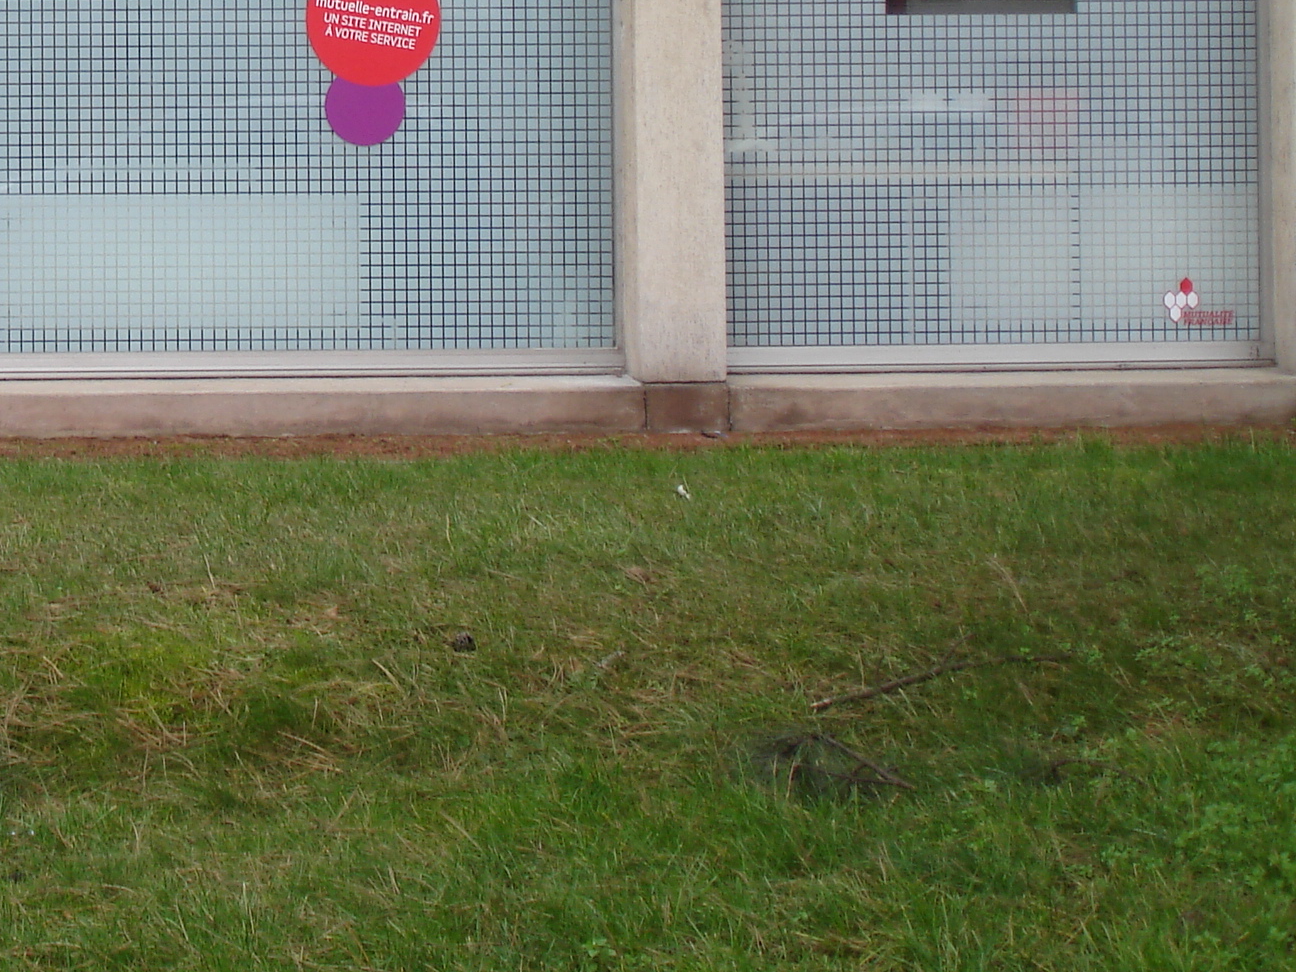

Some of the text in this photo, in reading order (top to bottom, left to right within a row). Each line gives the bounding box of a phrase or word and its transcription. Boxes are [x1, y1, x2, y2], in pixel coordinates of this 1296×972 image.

[324, 12, 422, 38] UN SITE INTERNET
[324, 23, 416, 50] À VOTRE SERVICE
